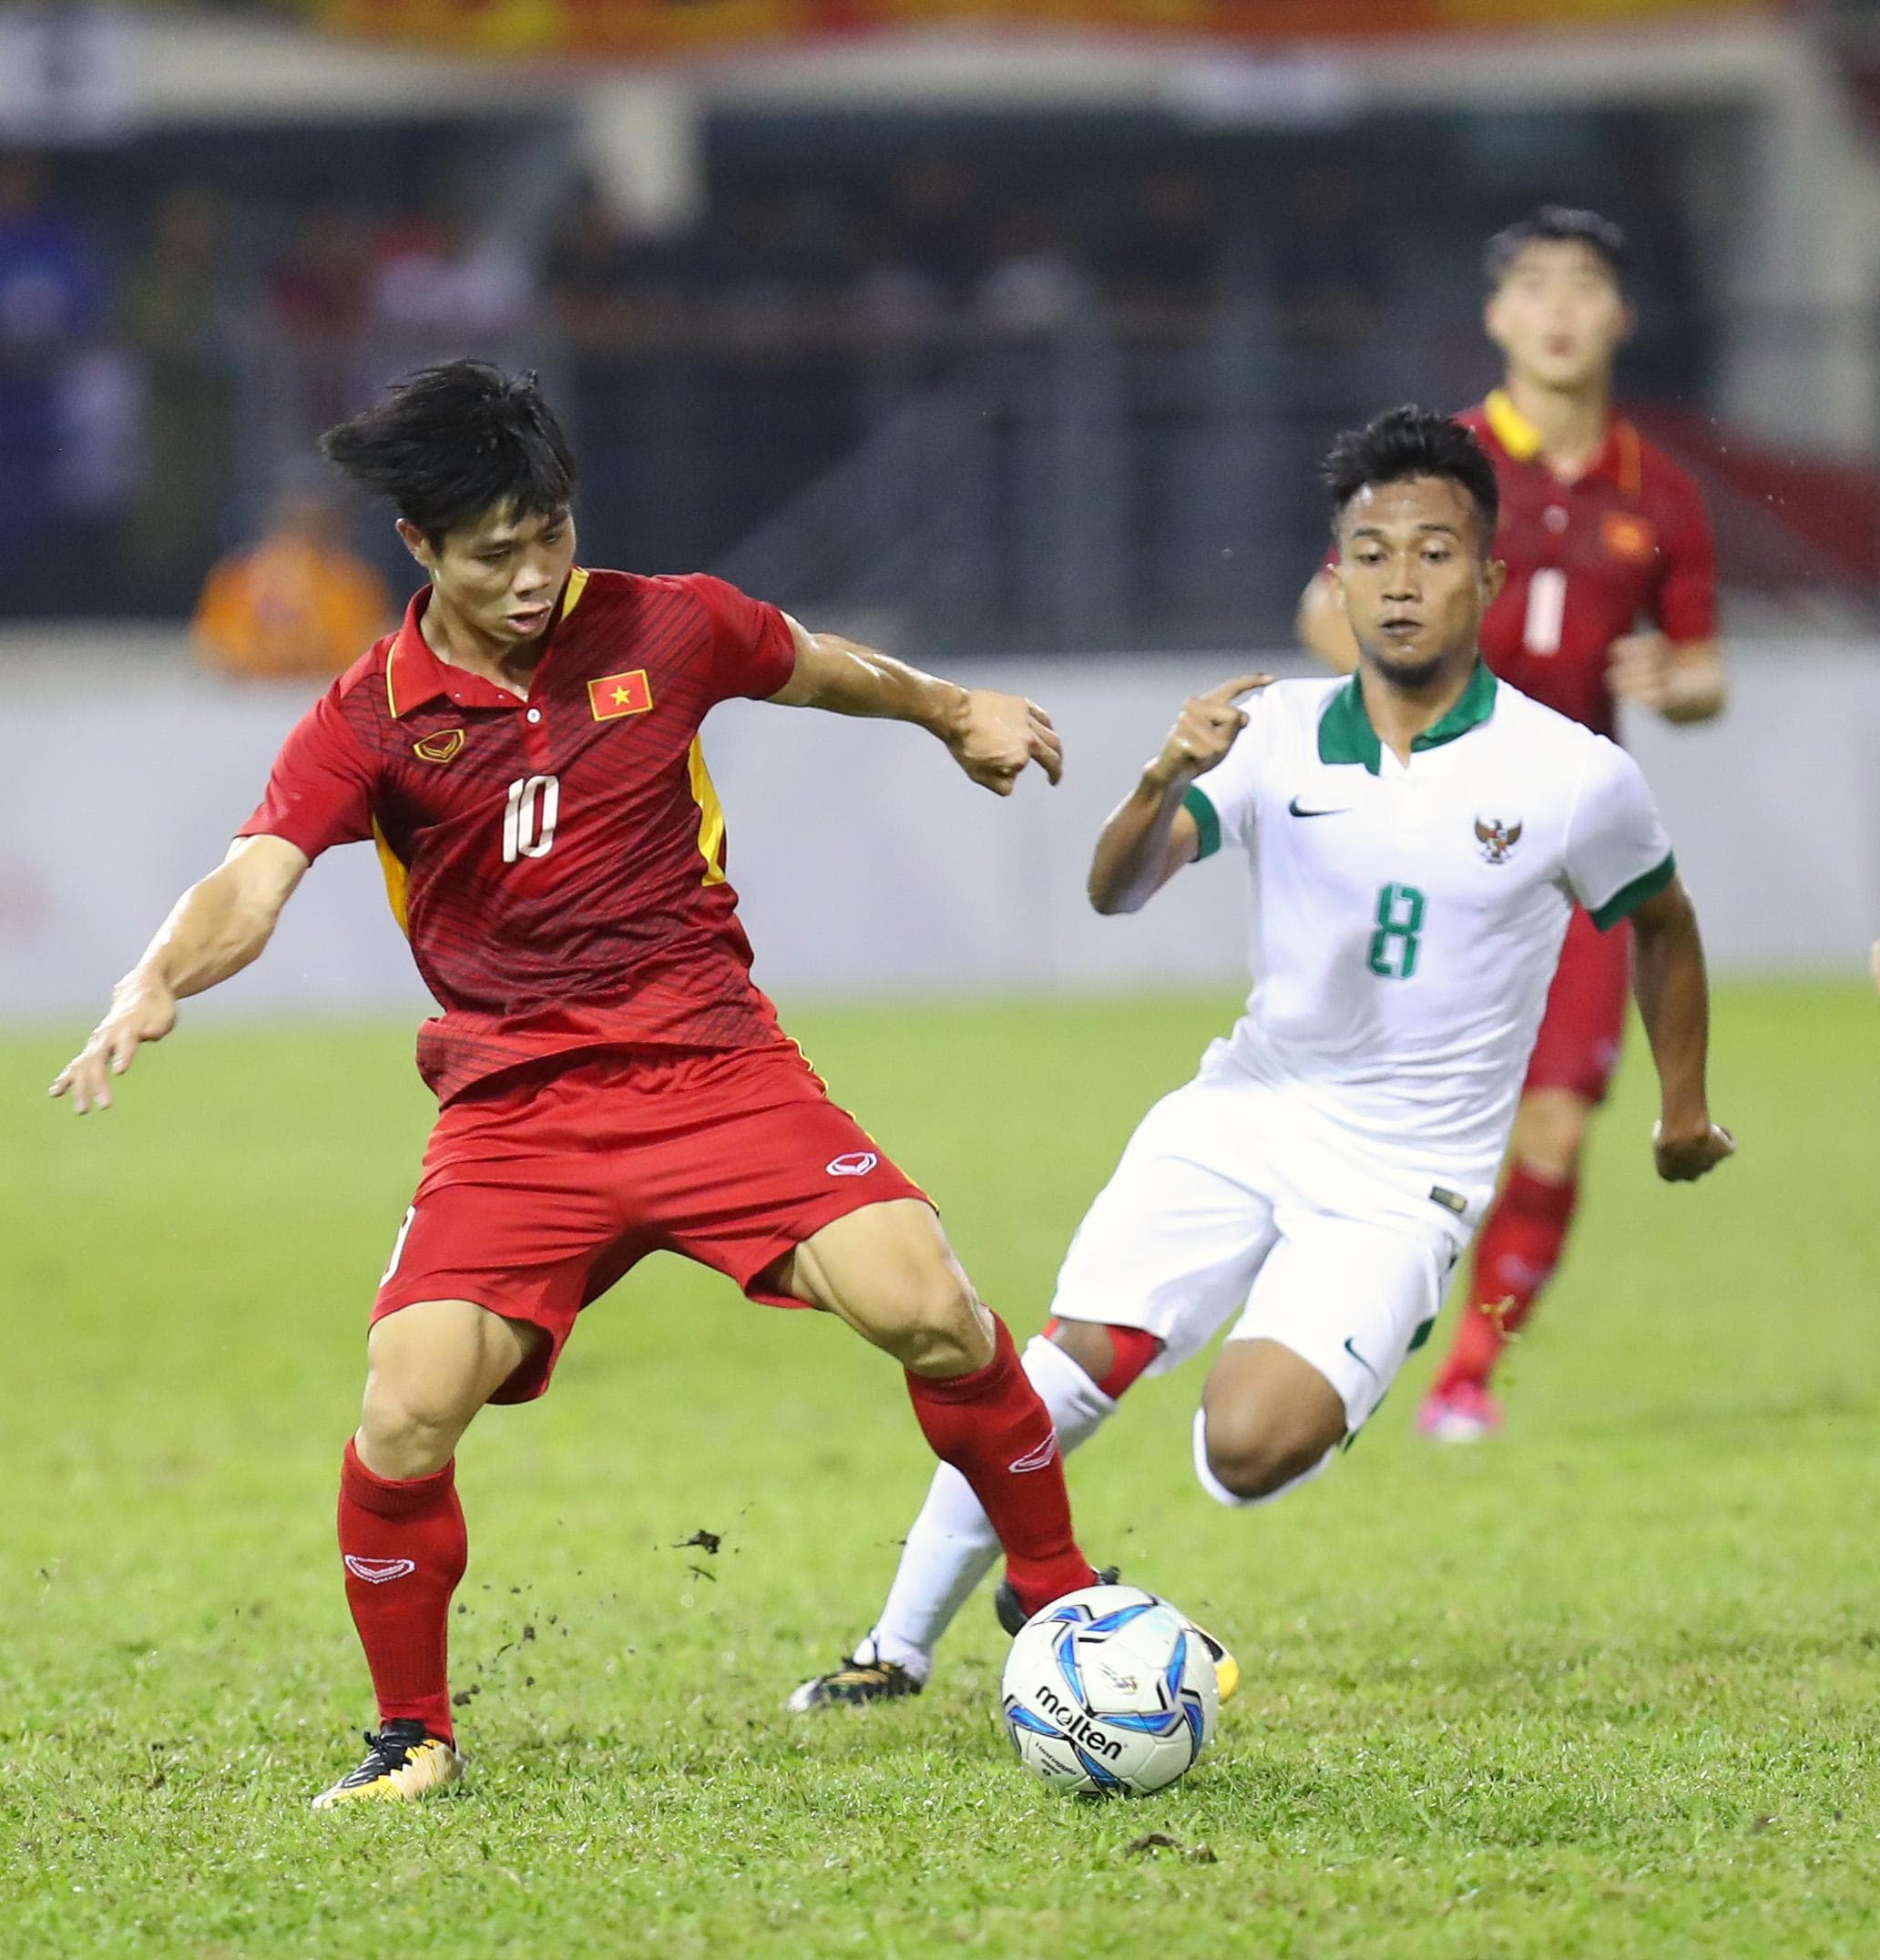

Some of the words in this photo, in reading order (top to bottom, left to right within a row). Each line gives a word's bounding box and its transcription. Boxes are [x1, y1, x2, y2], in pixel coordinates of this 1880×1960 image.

[503, 775, 560, 863] 10
[1368, 882, 1425, 980] 8
[1036, 1685, 1123, 1761] molten
